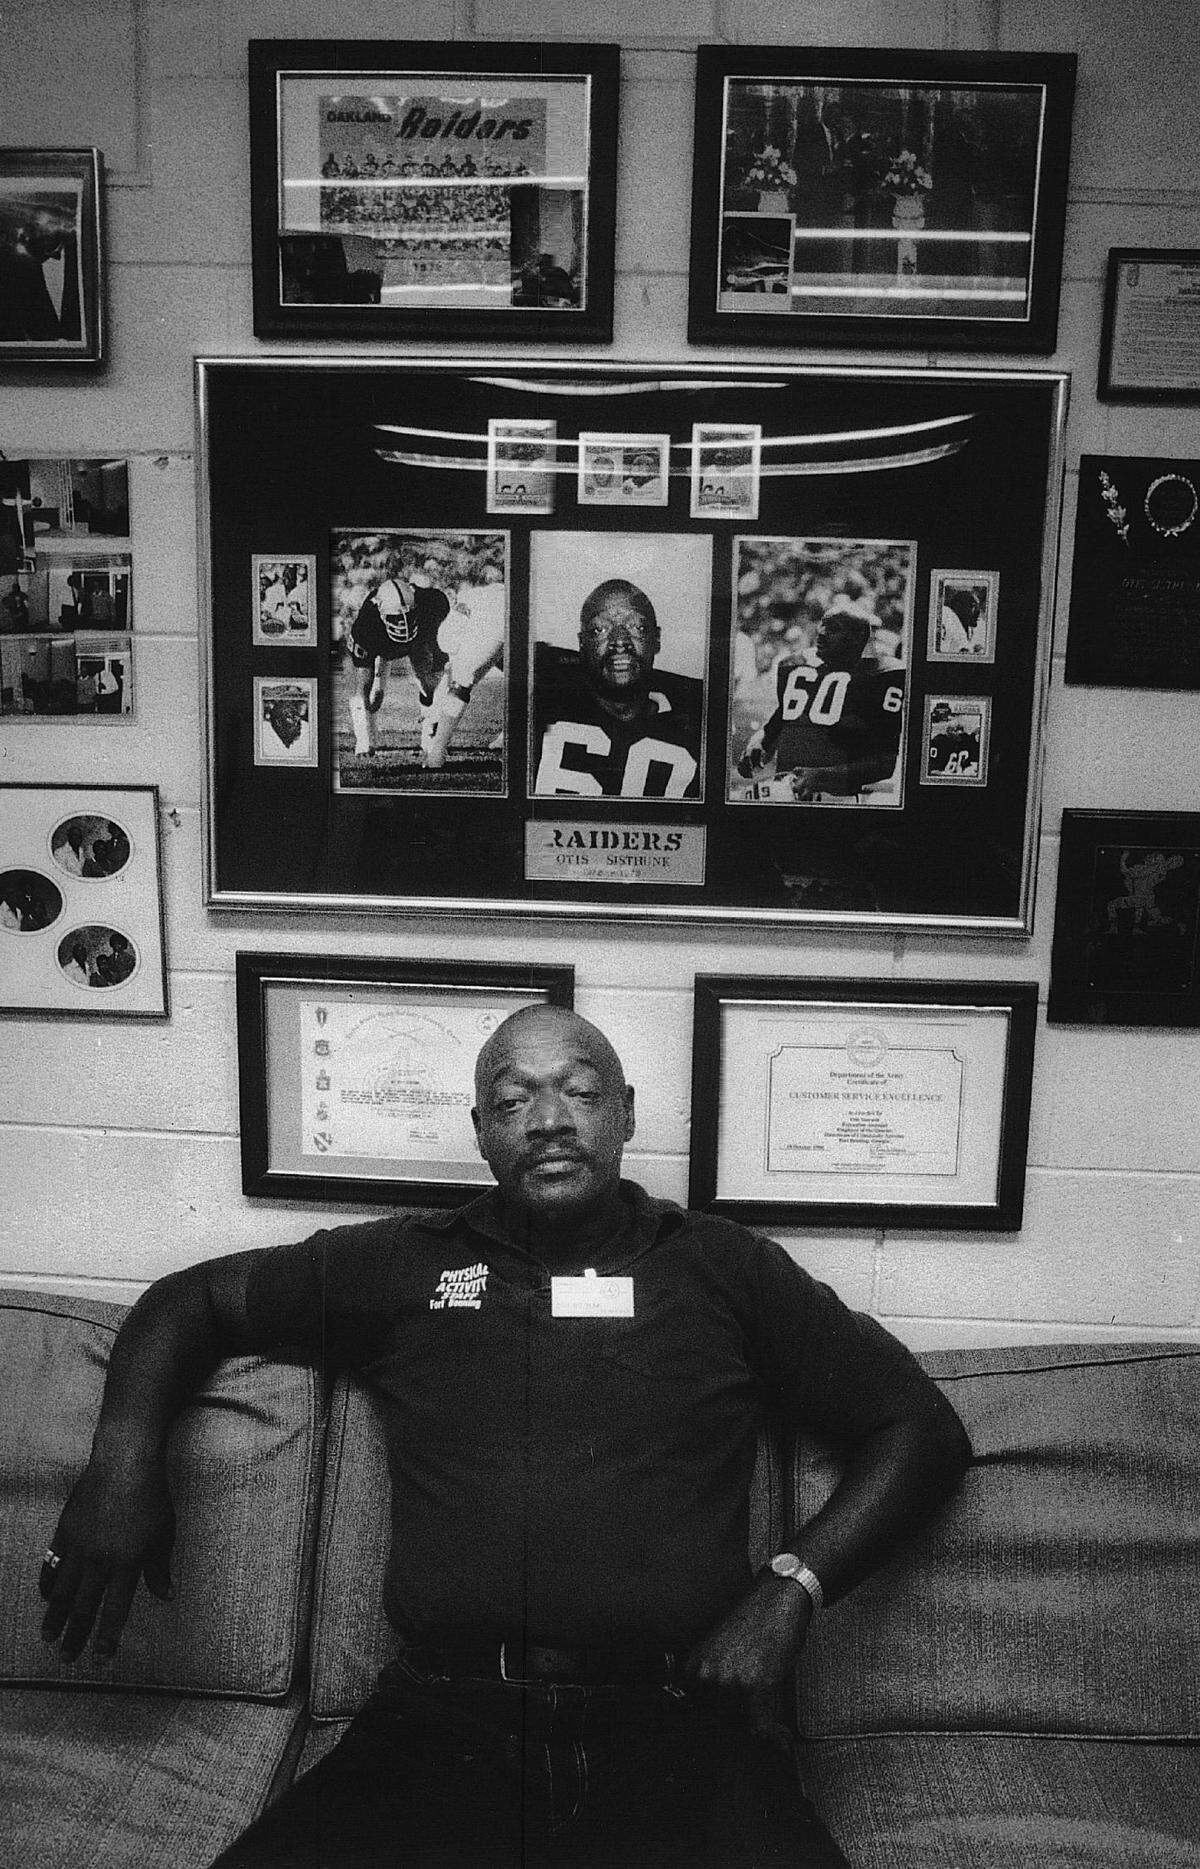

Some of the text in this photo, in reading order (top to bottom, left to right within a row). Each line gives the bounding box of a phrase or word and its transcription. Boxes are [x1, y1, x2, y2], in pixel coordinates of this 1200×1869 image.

[396, 106, 534, 140] Raiders
[783, 666, 852, 727] 60
[534, 720, 698, 798] 60
[546, 829, 683, 852] RAIDERS
[556, 854, 671, 868] OTIS SISTRUNK
[788, 1092, 943, 1102] CUSTOMER SERVICE EXCELLENCE
[440, 1262, 490, 1283] PHYSICAL
[435, 1276, 487, 1293] ACTIVITY
[429, 1299, 445, 1310] Fort
